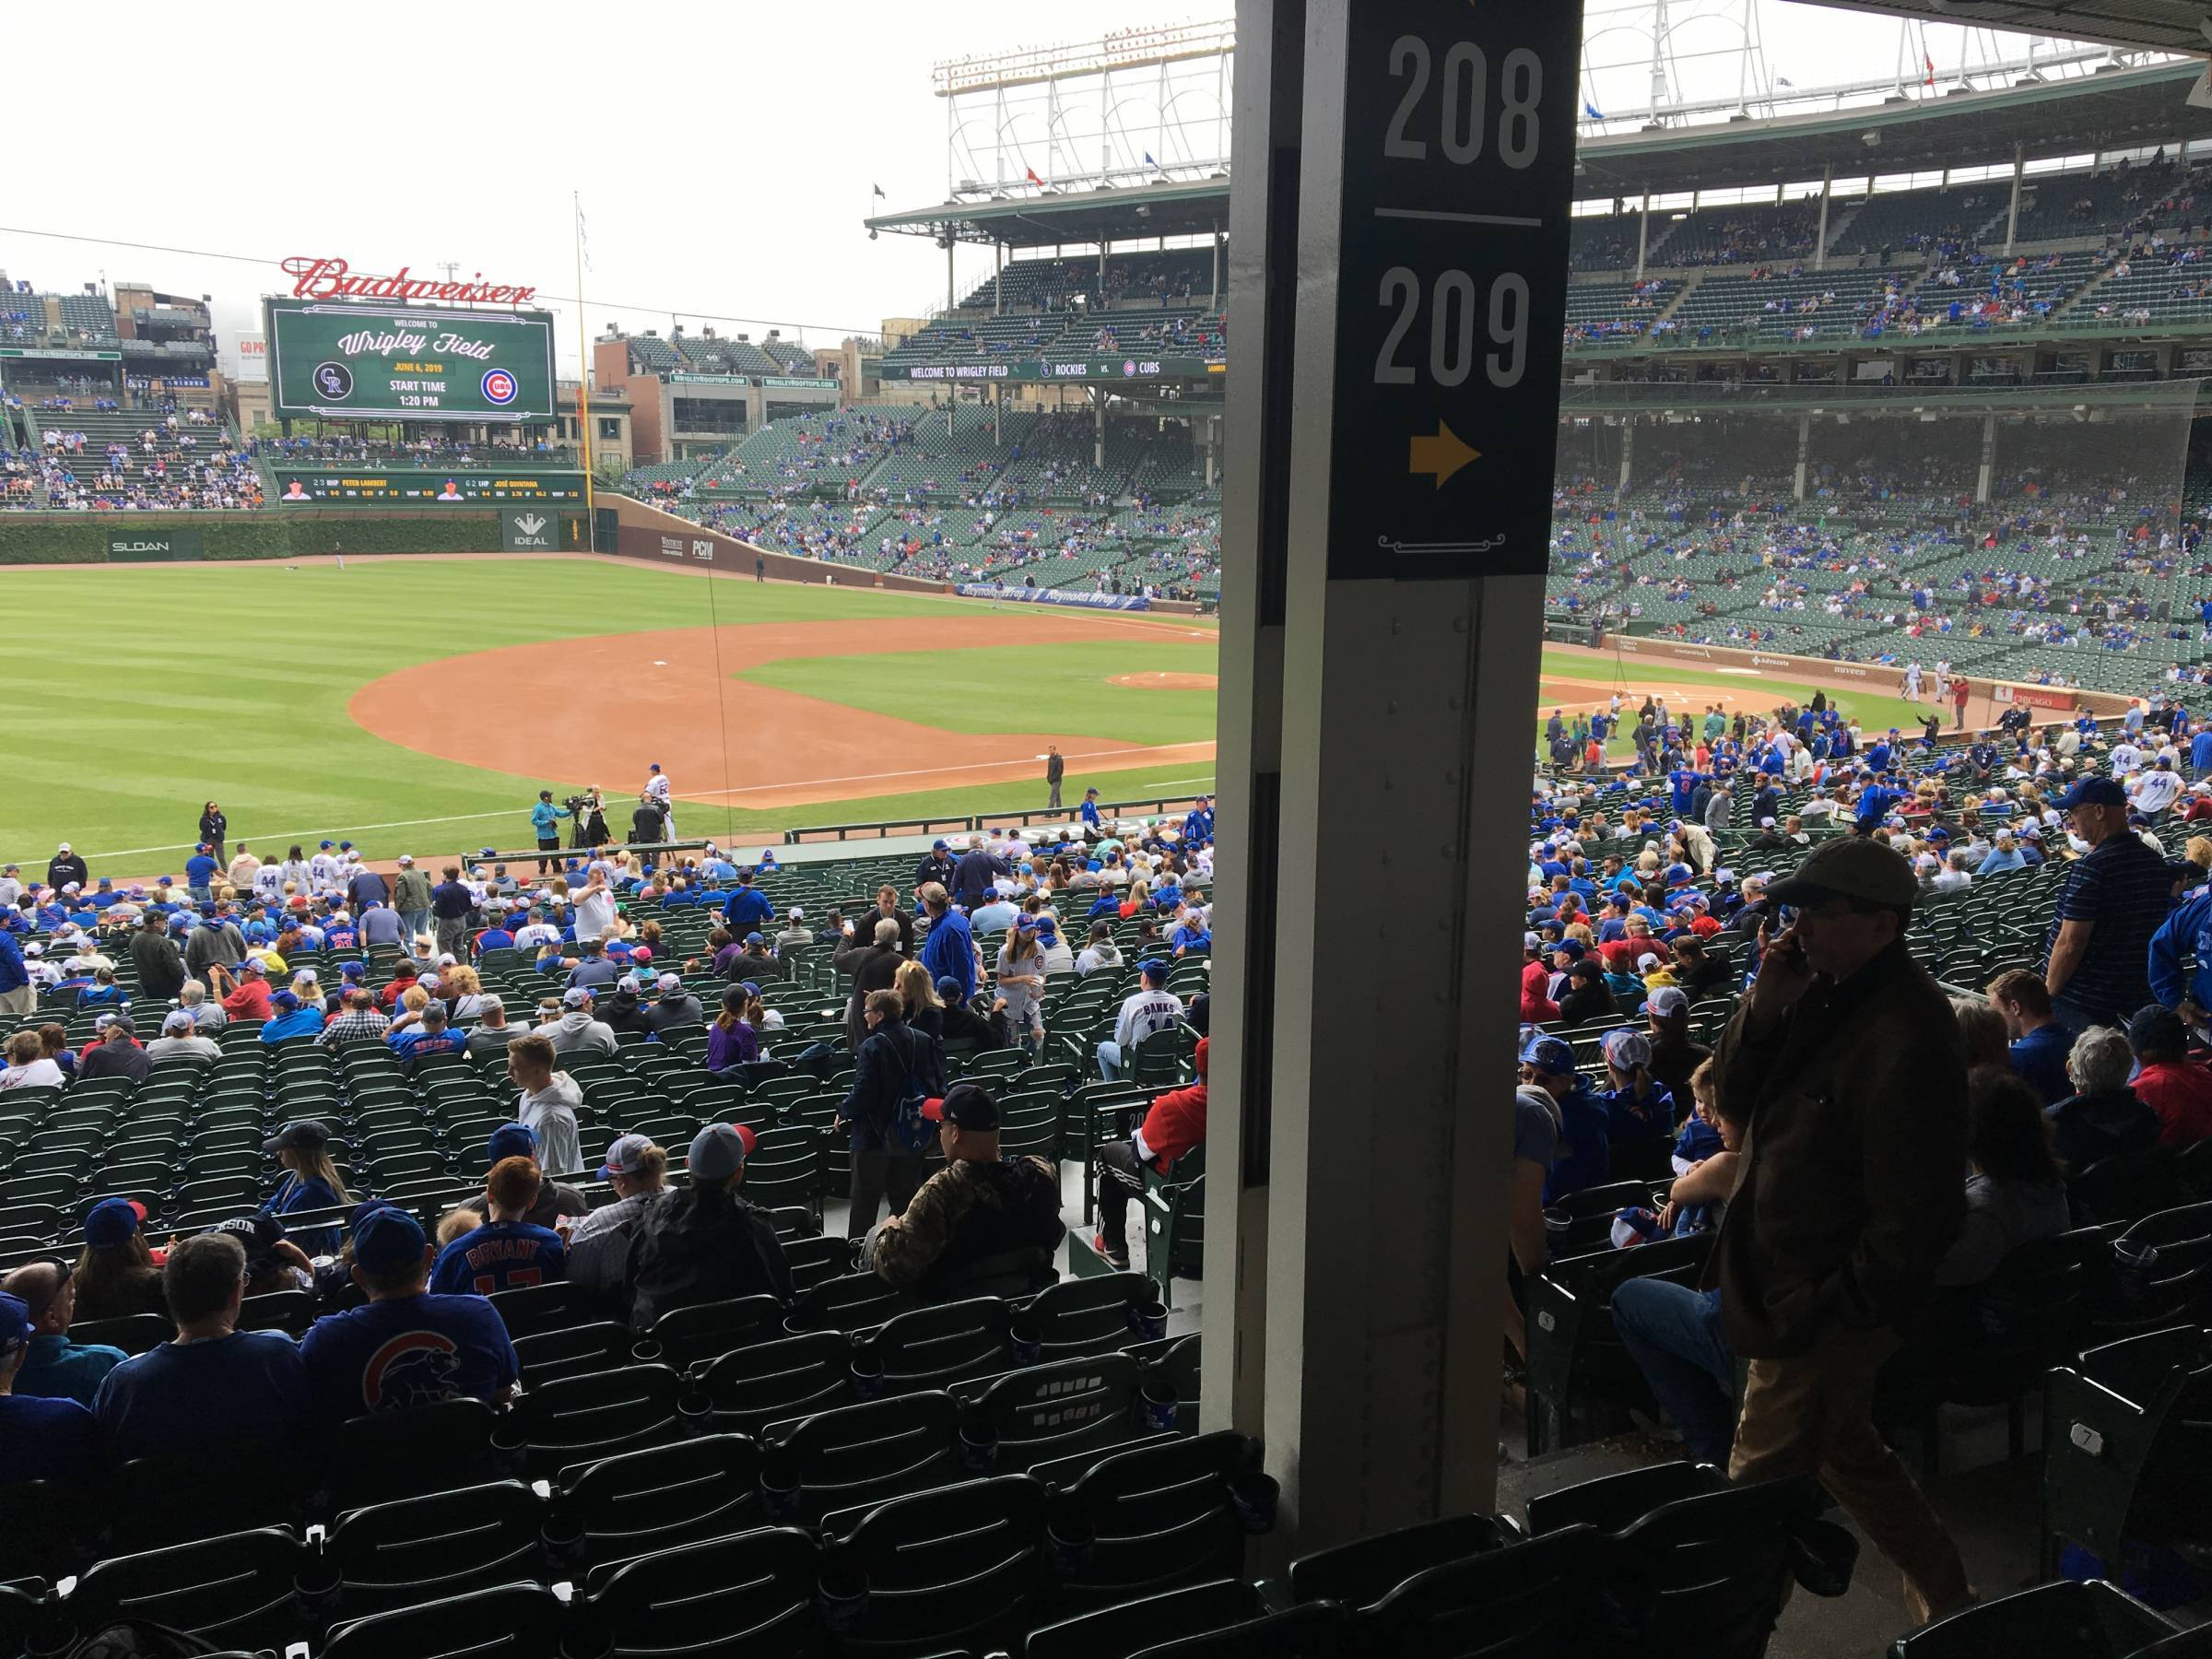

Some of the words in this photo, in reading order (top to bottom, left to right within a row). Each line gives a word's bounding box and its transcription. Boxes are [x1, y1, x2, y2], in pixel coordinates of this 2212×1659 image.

[1384, 35, 1543, 169] 208
[281, 256, 536, 303] Budweiser
[394, 320, 428, 328] WELCOME
[429, 321, 438, 329] TO
[1374, 266, 1530, 388] 209
[241, 340, 252, 354] GO
[337, 329, 427, 356] Wrigley
[433, 333, 496, 360] Field
[394, 361, 415, 371] JUNE
[425, 363, 443, 373] 2019
[911, 367, 944, 378] WELCOME
[946, 367, 955, 378] TO
[956, 366, 987, 377] WRIGLEY
[989, 365, 1008, 377] FIELD
[1055, 363, 1087, 375] ROCKIES
[1139, 362, 1159, 373] CUBS
[390, 380, 419, 392] START
[421, 381, 446, 393] TIME
[399, 395, 420, 406] 1:20
[422, 396, 439, 407] PM
[112, 541, 170, 552] SLOAN
[514, 536, 548, 546] IDEAL
[1045, 589, 1091, 602] Reynolds
[1089, 593, 1118, 605] Wrap
[1760, 657, 1790, 667] Advocate
[1834, 665, 1866, 677] nuveen
[2014, 694, 2052, 707] CHICAGO
[2116, 754, 2131, 766] 44
[2150, 777, 2168, 790] 44
[313, 866, 324, 878] 44
[262, 875, 276, 888] 44
[1143, 1002, 1174, 1015] BANKS
[465, 1238, 541, 1270] BRYANT
[2083, 1430, 2092, 1445] 7
